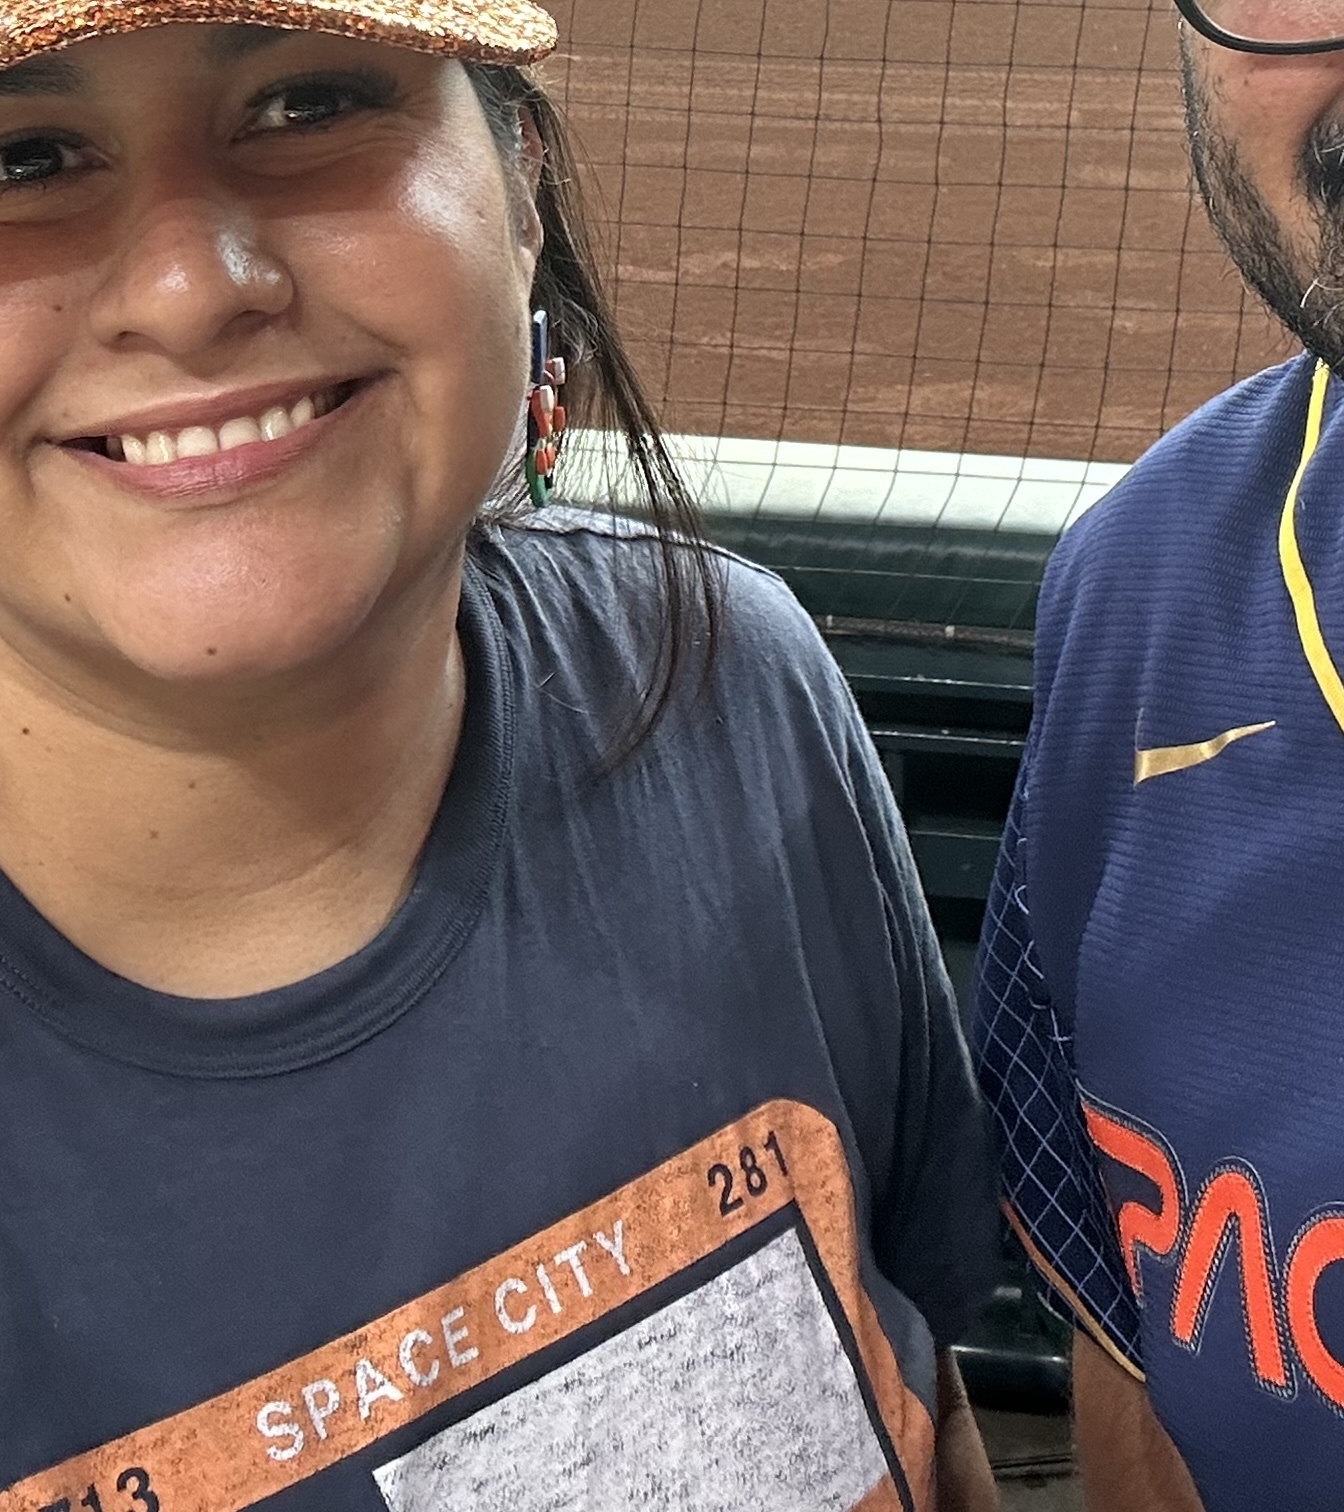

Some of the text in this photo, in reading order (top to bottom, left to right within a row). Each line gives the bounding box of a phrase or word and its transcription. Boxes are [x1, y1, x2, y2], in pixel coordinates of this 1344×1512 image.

[708, 1130, 789, 1217] 281
[257, 1219, 635, 1463] SPACE CITY
